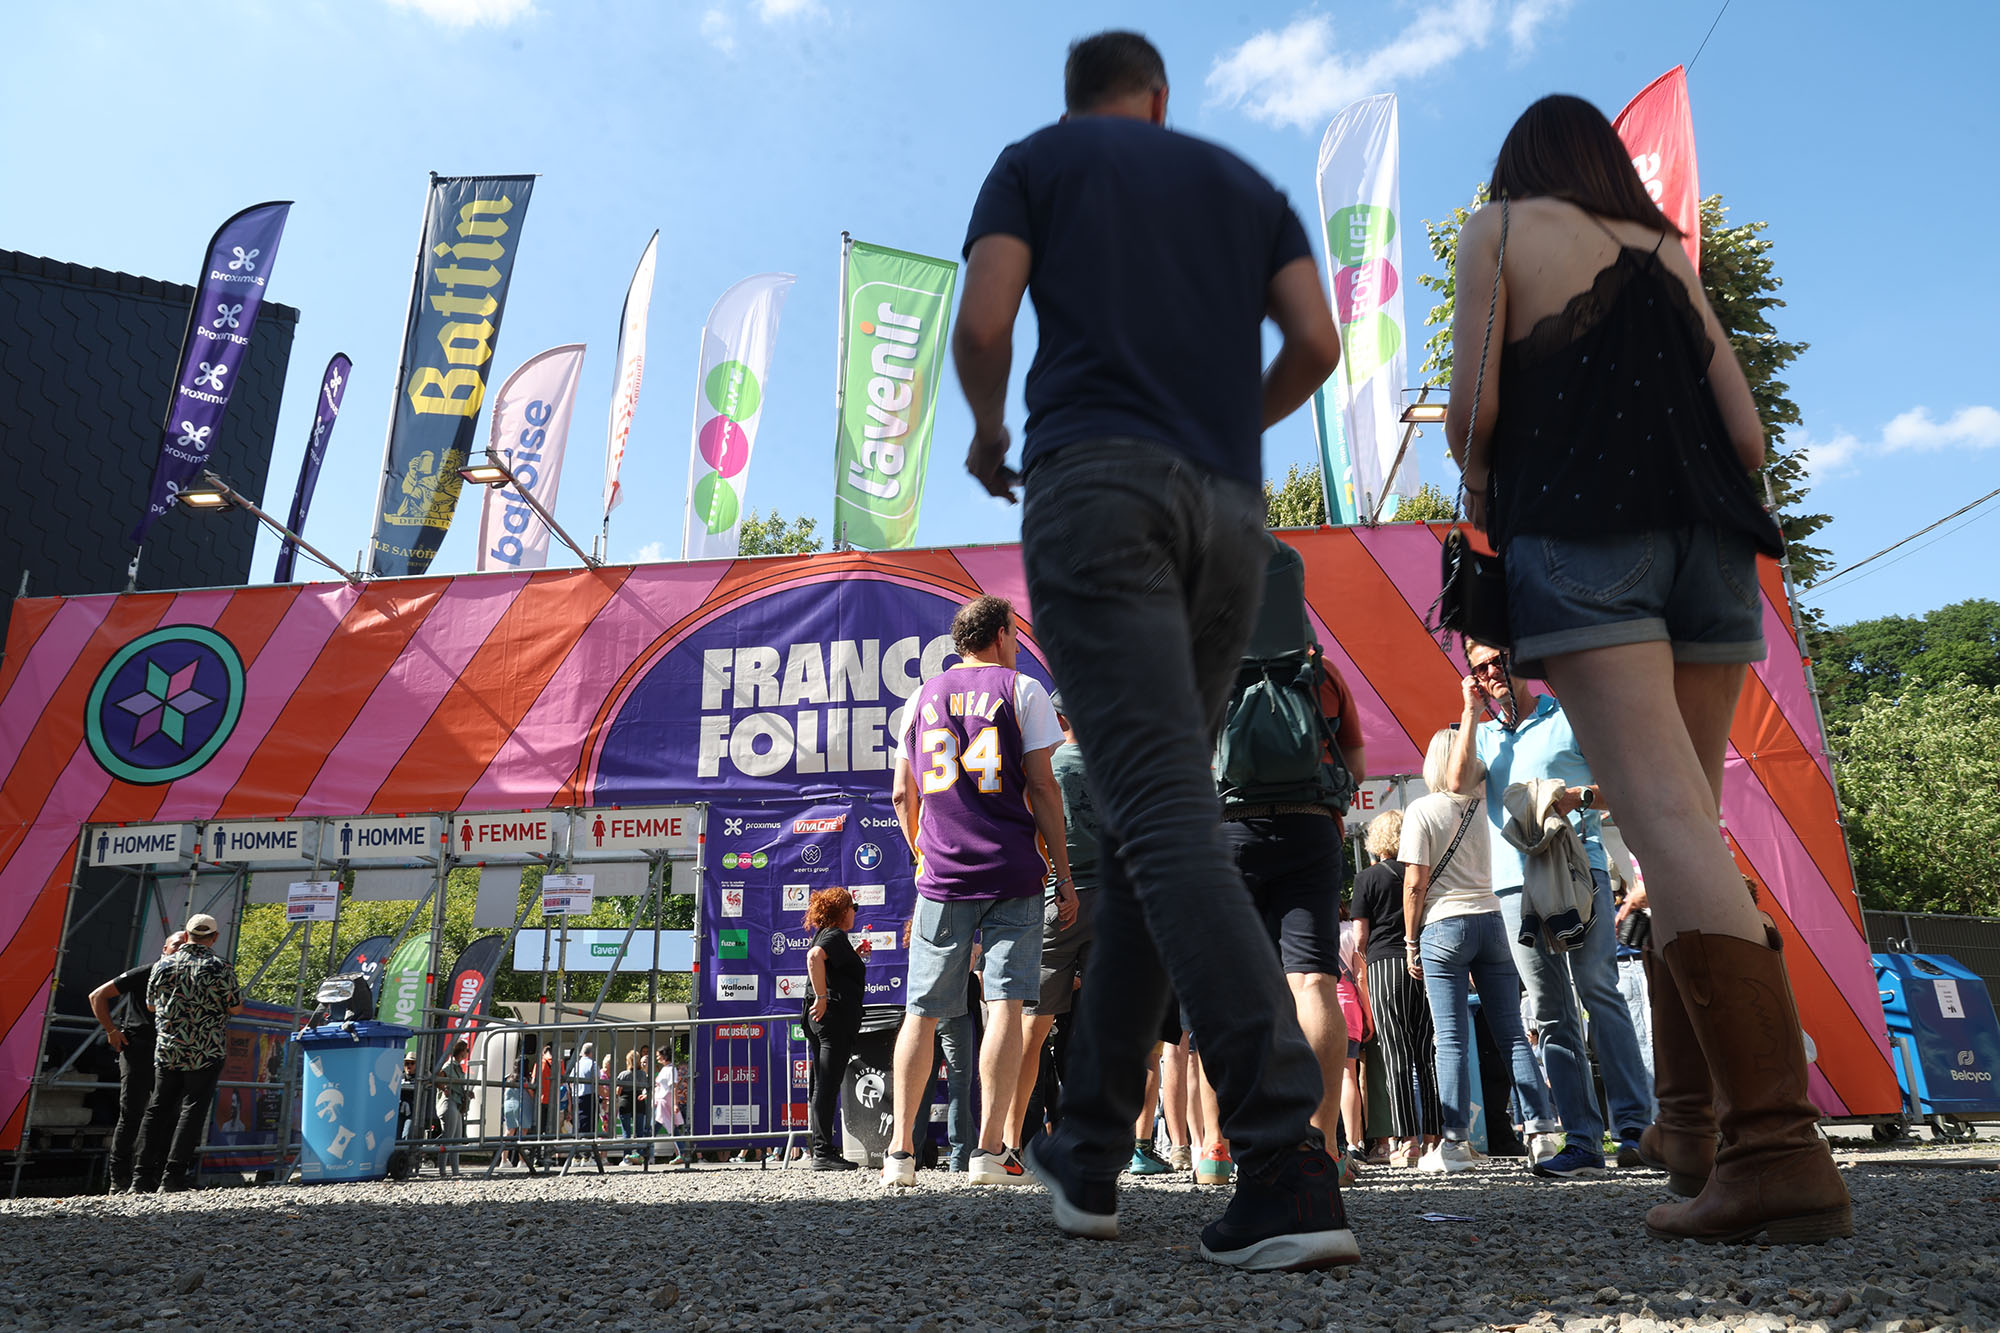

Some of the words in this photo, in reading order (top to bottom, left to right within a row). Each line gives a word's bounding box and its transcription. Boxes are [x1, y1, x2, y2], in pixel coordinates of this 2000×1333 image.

[1350, 212, 1372, 264] LIFE
[211, 270, 265, 286] proximus
[407, 194, 513, 420] Battin
[196, 326, 249, 345] proximus
[490, 400, 552, 566] baloise
[399, 517, 437, 525] DEPUIS
[374, 541, 390, 552] LE
[922, 726, 1003, 795] 34
[479, 821, 547, 843] FEMME
[611, 817, 682, 839] FEMME
[745, 821, 781, 830] proximus
[112, 833, 177, 855] HOMME
[230, 830, 298, 850] HOMME
[358, 825, 425, 847] HOMME
[718, 1026, 760, 1039] moustique
[717, 1070, 729, 1082] La
[731, 1068, 756, 1082] Libre
[855, 1067, 885, 1080] AUTRES
[1951, 1069, 1992, 1083] Belcyco
